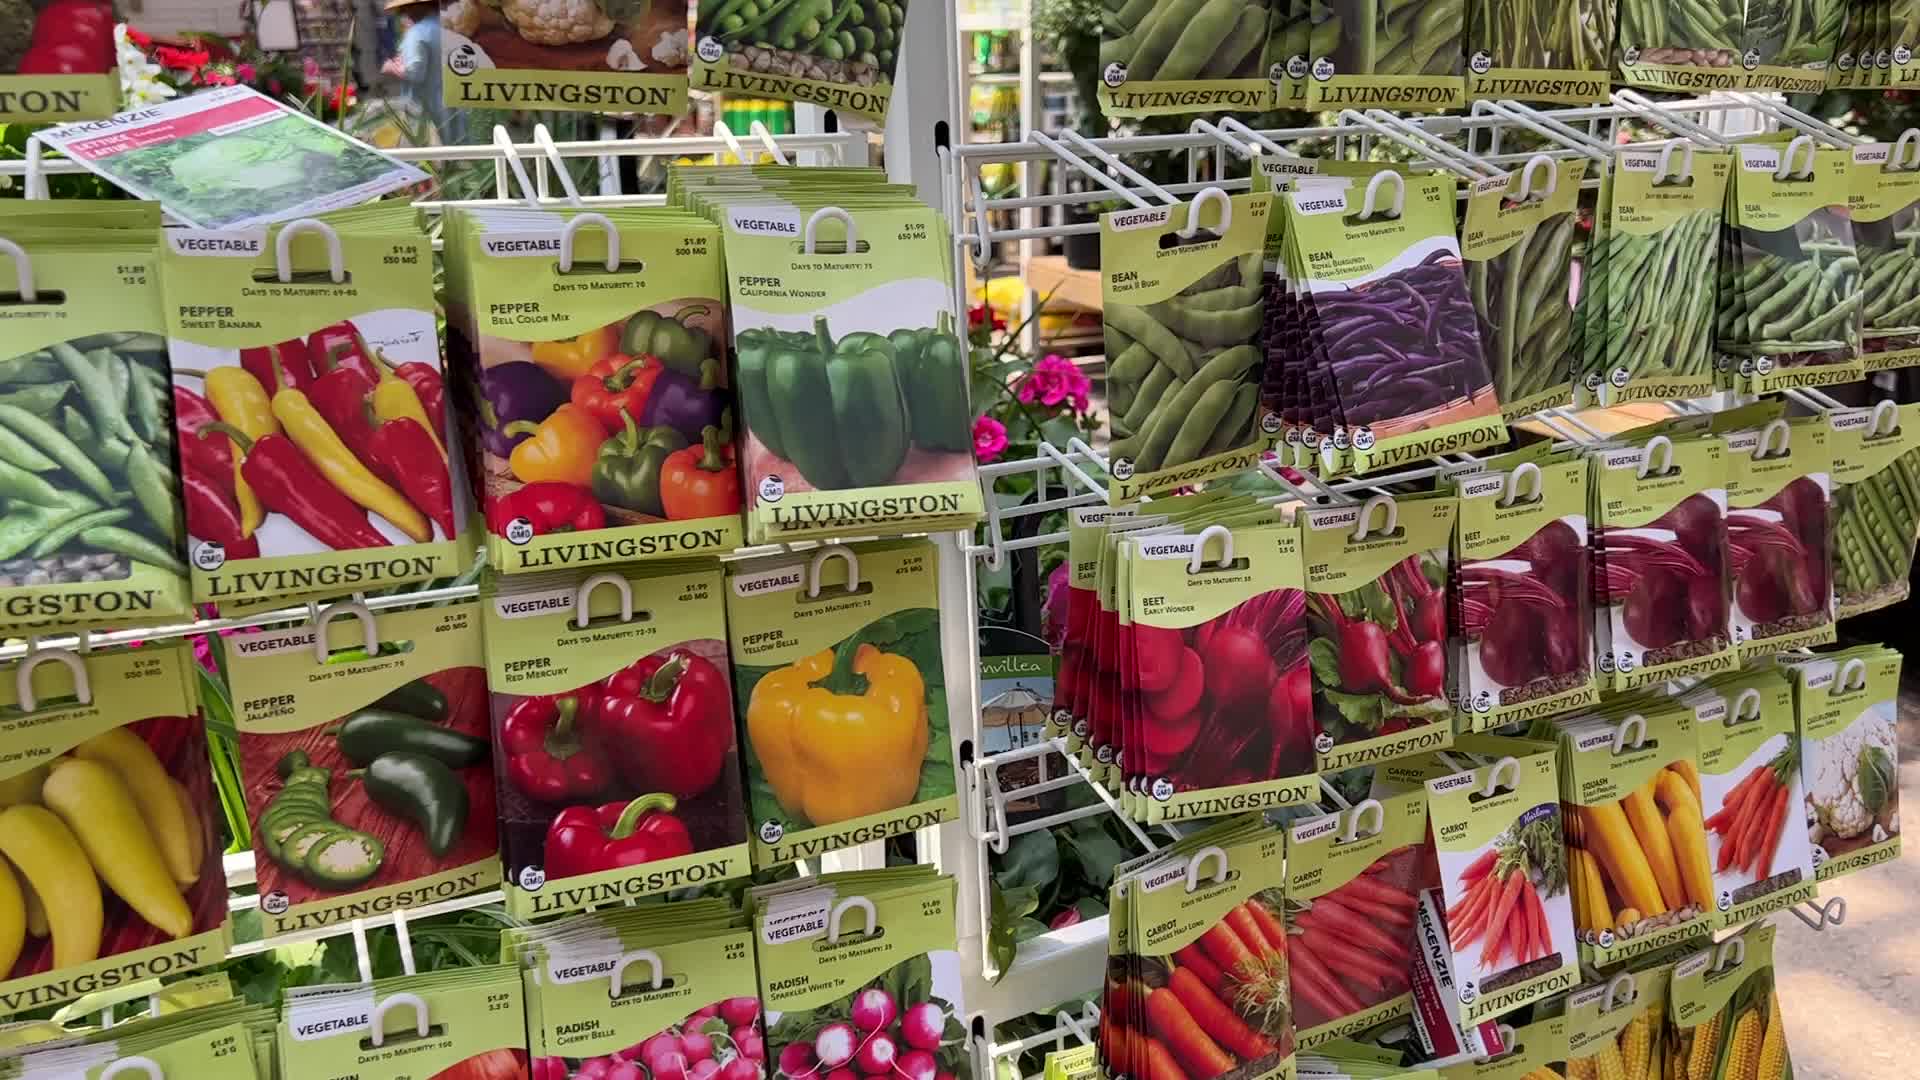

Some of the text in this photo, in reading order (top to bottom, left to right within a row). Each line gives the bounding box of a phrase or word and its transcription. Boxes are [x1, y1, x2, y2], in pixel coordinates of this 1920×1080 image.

[1632, 70, 1740, 88] LIVINGSTON
[1745, 74, 1826, 92] LIVINGSTON
[460, 82, 670, 106] LIVINGSTON
[703, 69, 885, 113] LIVINGSTON
[1320, 87, 1456, 103] LIVINGSTON
[1474, 79, 1604, 96] LIVINGSTON
[1109, 91, 1262, 108] LIVINGSTON
[1625, 160, 1656, 168] VEGETABLE
[1745, 160, 1776, 168] VEGETABLE
[1855, 152, 1886, 161] VEGETABLE
[1263, 164, 1315, 175] VEGETABLE
[1299, 199, 1344, 211] VEGETABLE
[735, 219, 796, 233] VEGETABLE
[1114, 212, 1166, 226] VEGETABLE
[905, 223, 925, 231] $1.99
[684, 238, 707, 246] $1.89
[913, 232, 926, 240] MG
[177, 238, 259, 252] VEGETABLE
[392, 246, 417, 254] $1.89
[488, 240, 561, 252] VEGETABLE
[675, 248, 707, 257] 500 MG
[403, 256, 417, 264] MG
[1309, 251, 1332, 262] BEAN
[739, 276, 781, 288] PEPPER
[1112, 272, 1137, 283] BEAN
[179, 306, 235, 318] PEPPER
[490, 303, 540, 314] PEPPER
[1763, 369, 1860, 391] LIVINGSTON
[1617, 384, 1712, 403] LIVINGSTON
[1834, 416, 1869, 427] VEGETABLE
[1356, 437, 1373, 445] GMO
[1368, 424, 1499, 469] LIVINGSTON
[1728, 439, 1757, 448] VEGETABLE
[1608, 455, 1642, 466] VEGETABLE
[1120, 452, 1257, 500] LIVINGSTON
[1465, 481, 1500, 495] VEGETABLE
[772, 494, 959, 523] LIVINGSTON
[1608, 501, 1622, 510] BEET
[1313, 512, 1356, 527] VEGETABLE
[1465, 531, 1480, 541] BEET
[519, 528, 723, 567] LIVINGSTON
[1144, 543, 1194, 555] VEGETABLE
[208, 556, 436, 596] LIVINGSTON
[1309, 564, 1328, 574] BEET
[686, 584, 708, 592] $1.99
[740, 574, 800, 592] VEGETABLE
[694, 592, 708, 600] MG
[1143, 597, 1165, 607] BEET
[502, 597, 570, 614] VEGETABLE
[443, 614, 467, 622] $1.89
[453, 622, 467, 630] MG
[239, 634, 316, 653] VEGETABLE
[742, 630, 783, 646] PEPPER
[1737, 631, 1833, 657] LIVINGSTON
[505, 658, 551, 672] PEPPER
[1625, 656, 1733, 689] LIVINGSTON
[244, 695, 295, 712] PEPPER
[1483, 689, 1594, 729] LIVINGSTON
[1579, 733, 1613, 748] VEGETABLE
[1322, 730, 1445, 771] LIVINGSTON
[1388, 768, 1424, 777] CARROT
[1433, 775, 1473, 790] VEGETABLE
[1582, 777, 1608, 791] SQUASH
[1161, 786, 1308, 820] LIVINGSTON
[764, 831, 781, 840] GMO
[771, 808, 941, 863] LIVINGSTON
[1296, 821, 1337, 840] VEGETABLE
[1441, 821, 1468, 836] CARROT
[1815, 845, 1899, 881] LIVINGSTON
[524, 877, 543, 886] GMO
[1145, 867, 1186, 890] VEGETABLE
[1293, 868, 1323, 884] CARROT
[531, 859, 728, 913] LIVINGSTON
[276, 872, 480, 932] LIVINGSTON
[922, 900, 940, 909] $1.89
[1724, 886, 1812, 926] LIVINGSTON
[768, 919, 824, 941] VEGETABLE
[1146, 920, 1177, 938] CARROT
[1607, 920, 1711, 962] LIVINGSTON
[555, 961, 616, 980] VEGETABLE
[769, 975, 809, 992] RADISH
[1468, 975, 1572, 1021] LIVINGSTON
[297, 1014, 369, 1036] VEGETABLE
[556, 1020, 600, 1036] RADISH
